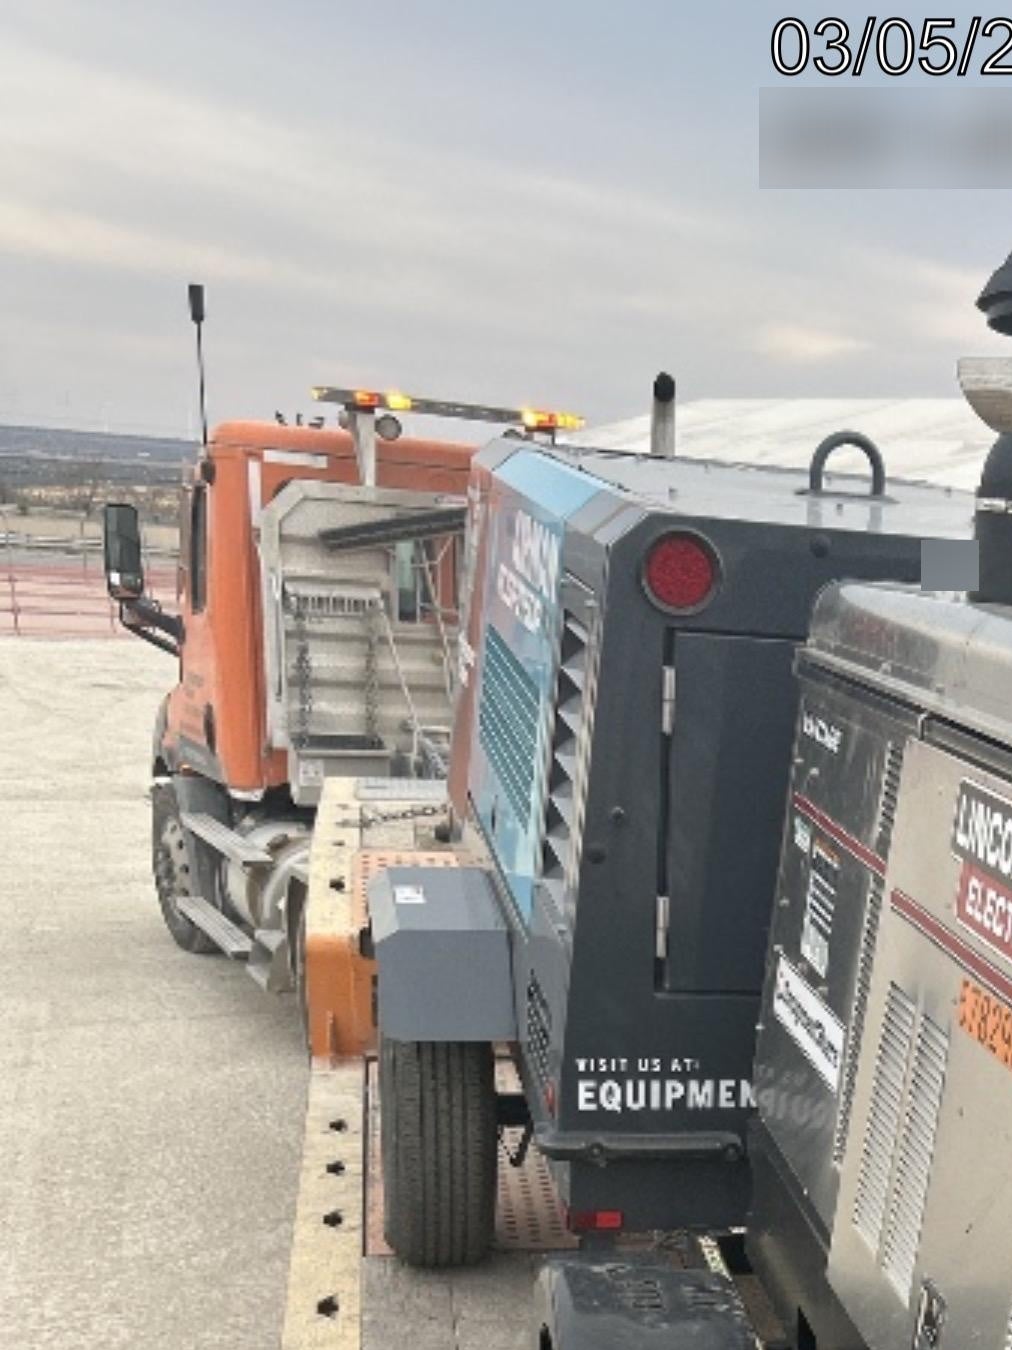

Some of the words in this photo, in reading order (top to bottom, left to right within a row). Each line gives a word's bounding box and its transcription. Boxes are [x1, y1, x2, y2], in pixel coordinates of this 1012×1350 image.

[575, 1058, 628, 1072] VISIT
[638, 1058, 661, 1072] US
[577, 1079, 758, 1113] EQUIPMEN
